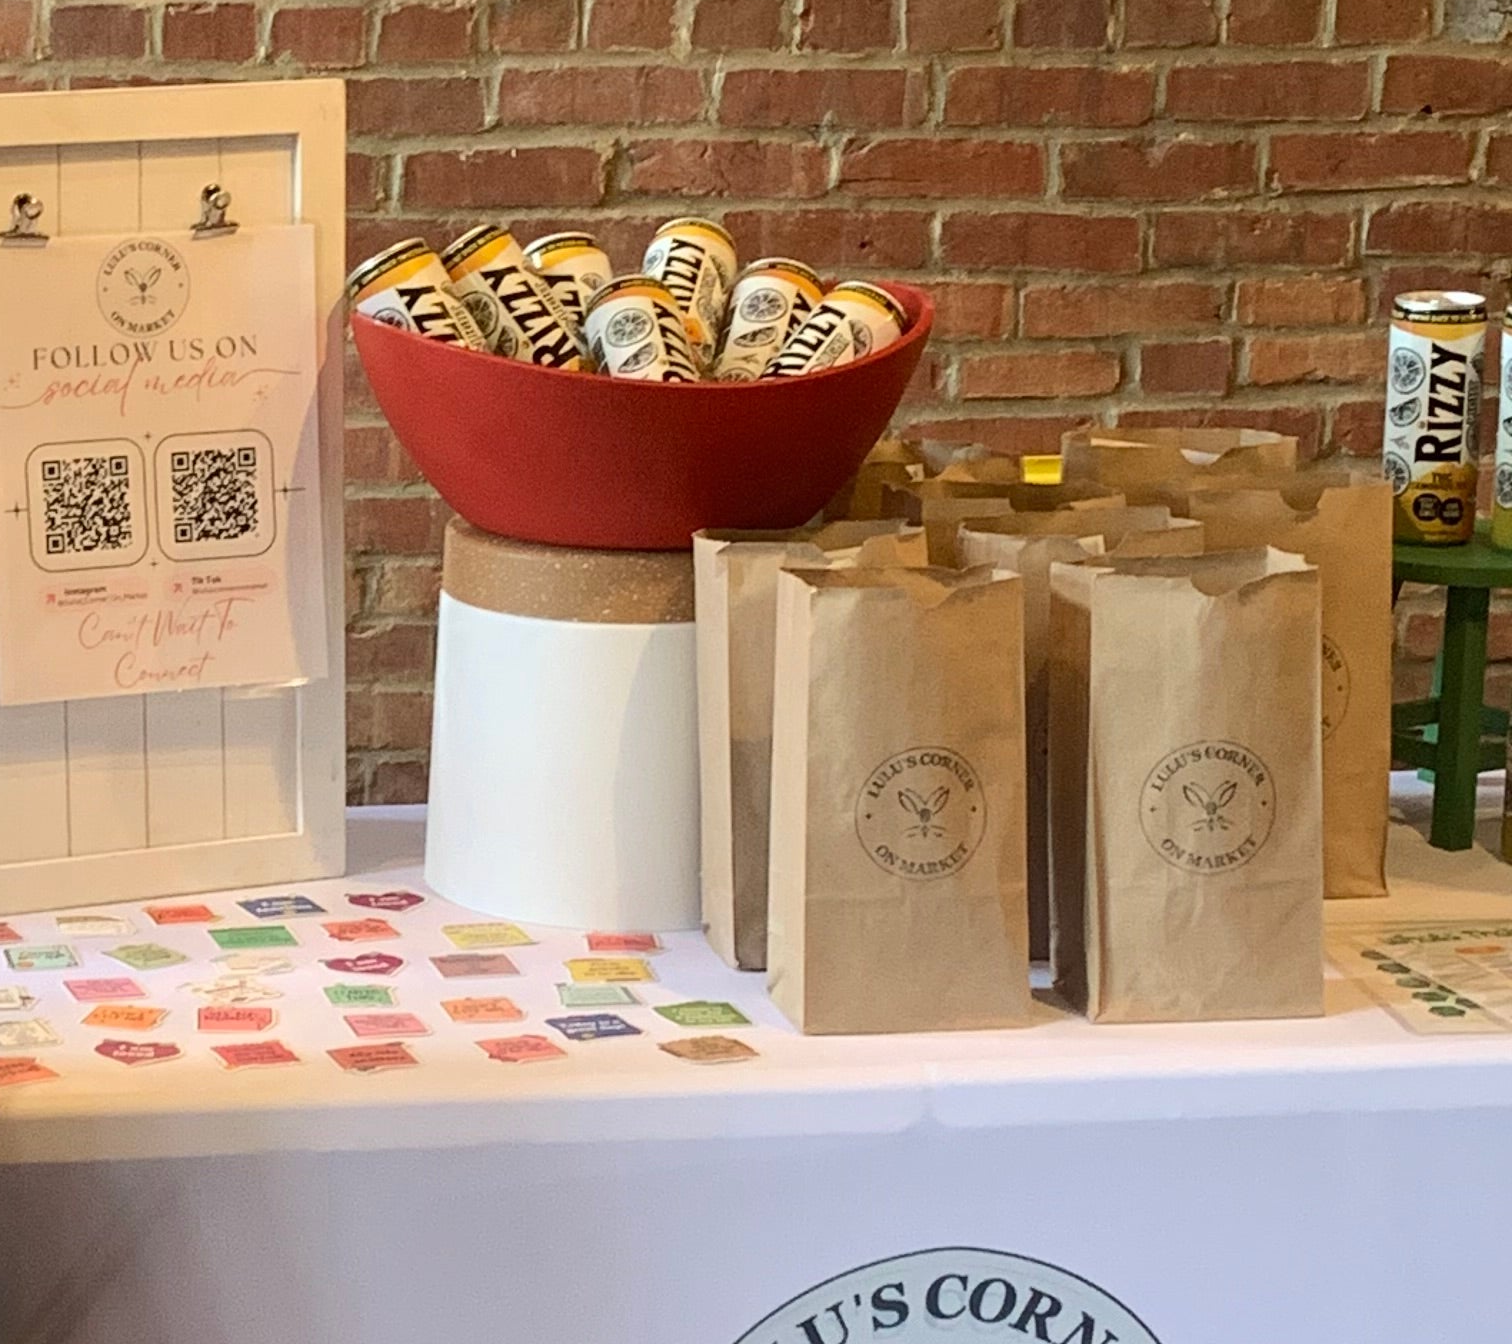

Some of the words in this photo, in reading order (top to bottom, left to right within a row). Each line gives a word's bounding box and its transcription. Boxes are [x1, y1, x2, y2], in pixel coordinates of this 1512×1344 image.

[138, 241, 181, 272] CORNER
[110, 311, 126, 327] ON
[126, 309, 176, 333] MARKET
[32, 340, 158, 371] FOLLOW
[169, 338, 204, 360] US
[216, 335, 258, 358] ON
[0, 357, 140, 417] social
[144, 356, 301, 402] media
[152, 598, 217, 646] Wait
[114, 651, 216, 689] Connect
[920, 753, 975, 792] CORNER
[1205, 746, 1265, 787] CORNER
[875, 844, 897, 866] ON
[899, 842, 968, 874] MARKET
[1161, 838, 1186, 859] ON
[1187, 835, 1256, 868] MARKET
